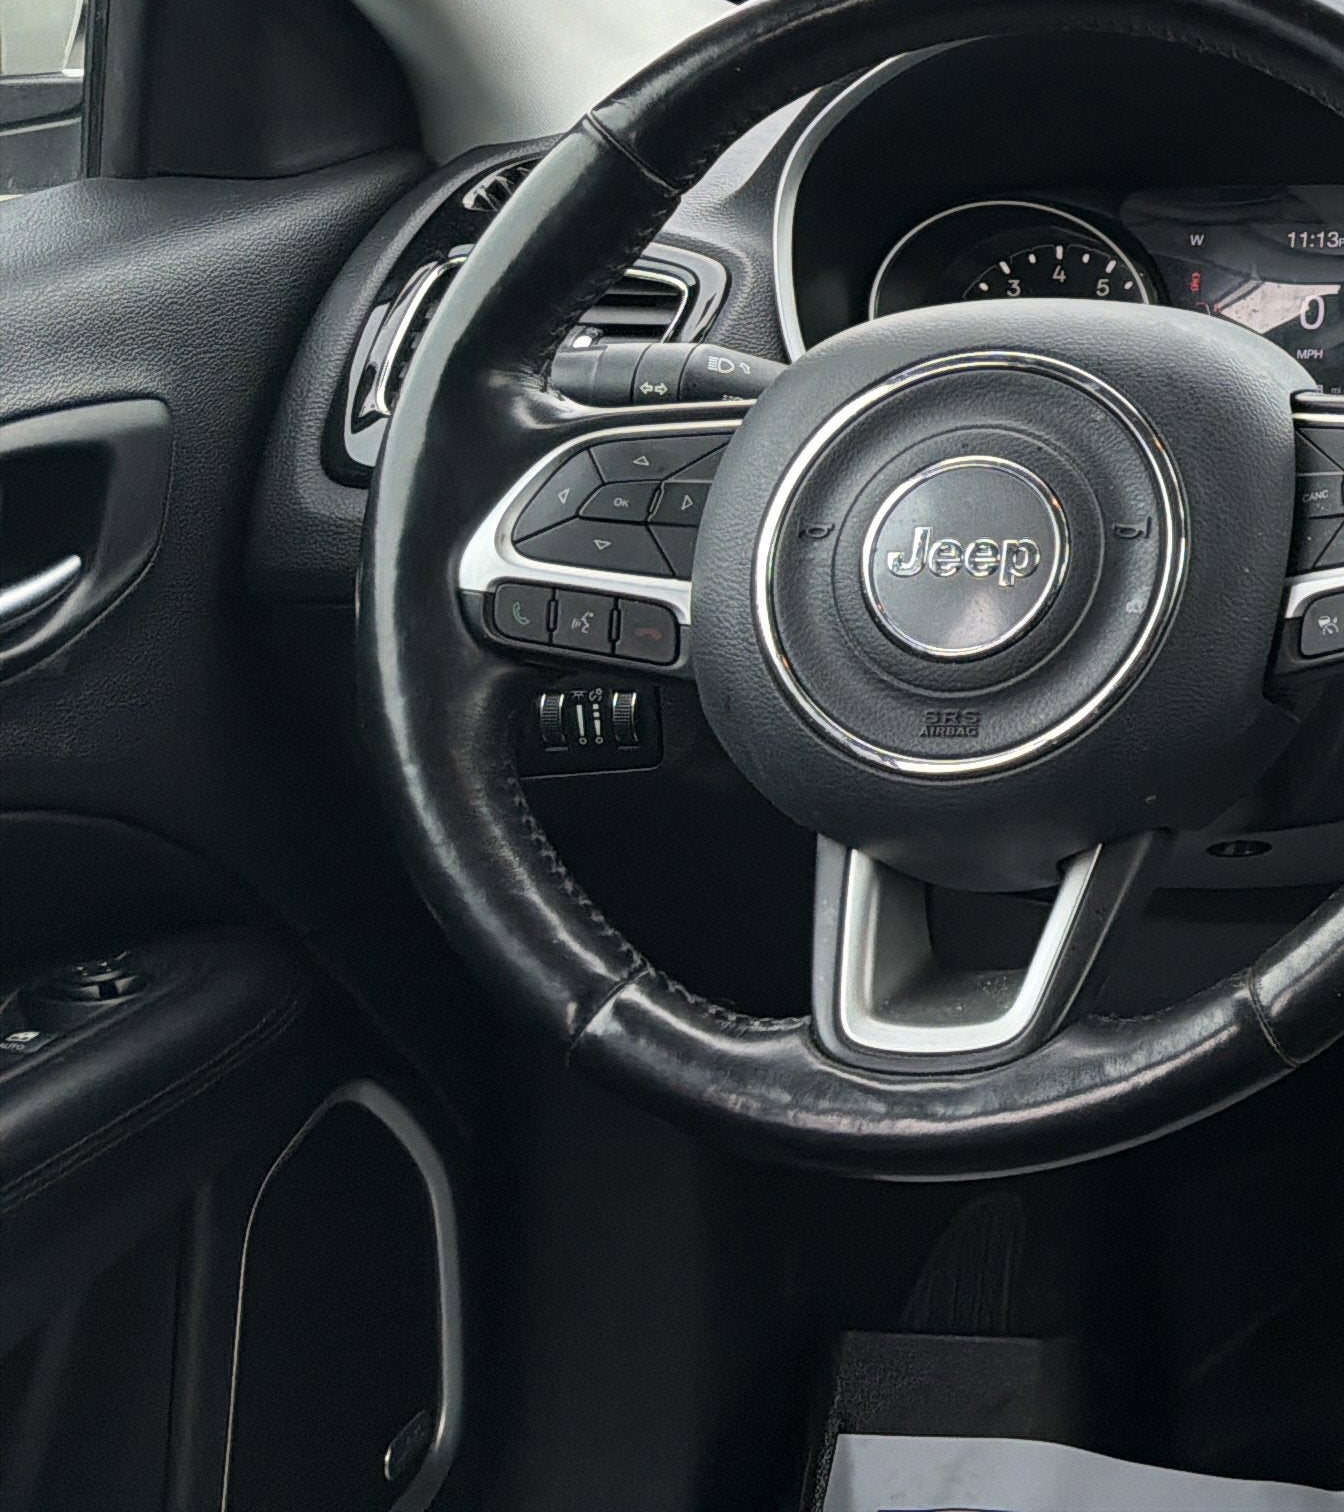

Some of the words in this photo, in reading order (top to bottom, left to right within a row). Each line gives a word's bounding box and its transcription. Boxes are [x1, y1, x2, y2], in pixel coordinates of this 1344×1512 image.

[1190, 234, 1205, 246] W
[1053, 267, 1066, 283] 4
[1007, 279, 1021, 297] 3
[1096, 279, 1109, 297] 5
[1299, 295, 1325, 330] 0
[1296, 349, 1323, 359] MPH
[614, 497, 628, 508] OK
[1302, 489, 1329, 503] CANC
[887, 527, 1041, 587] Jeep
[923, 710, 980, 724] SRS
[920, 725, 979, 738] AIRBAG
